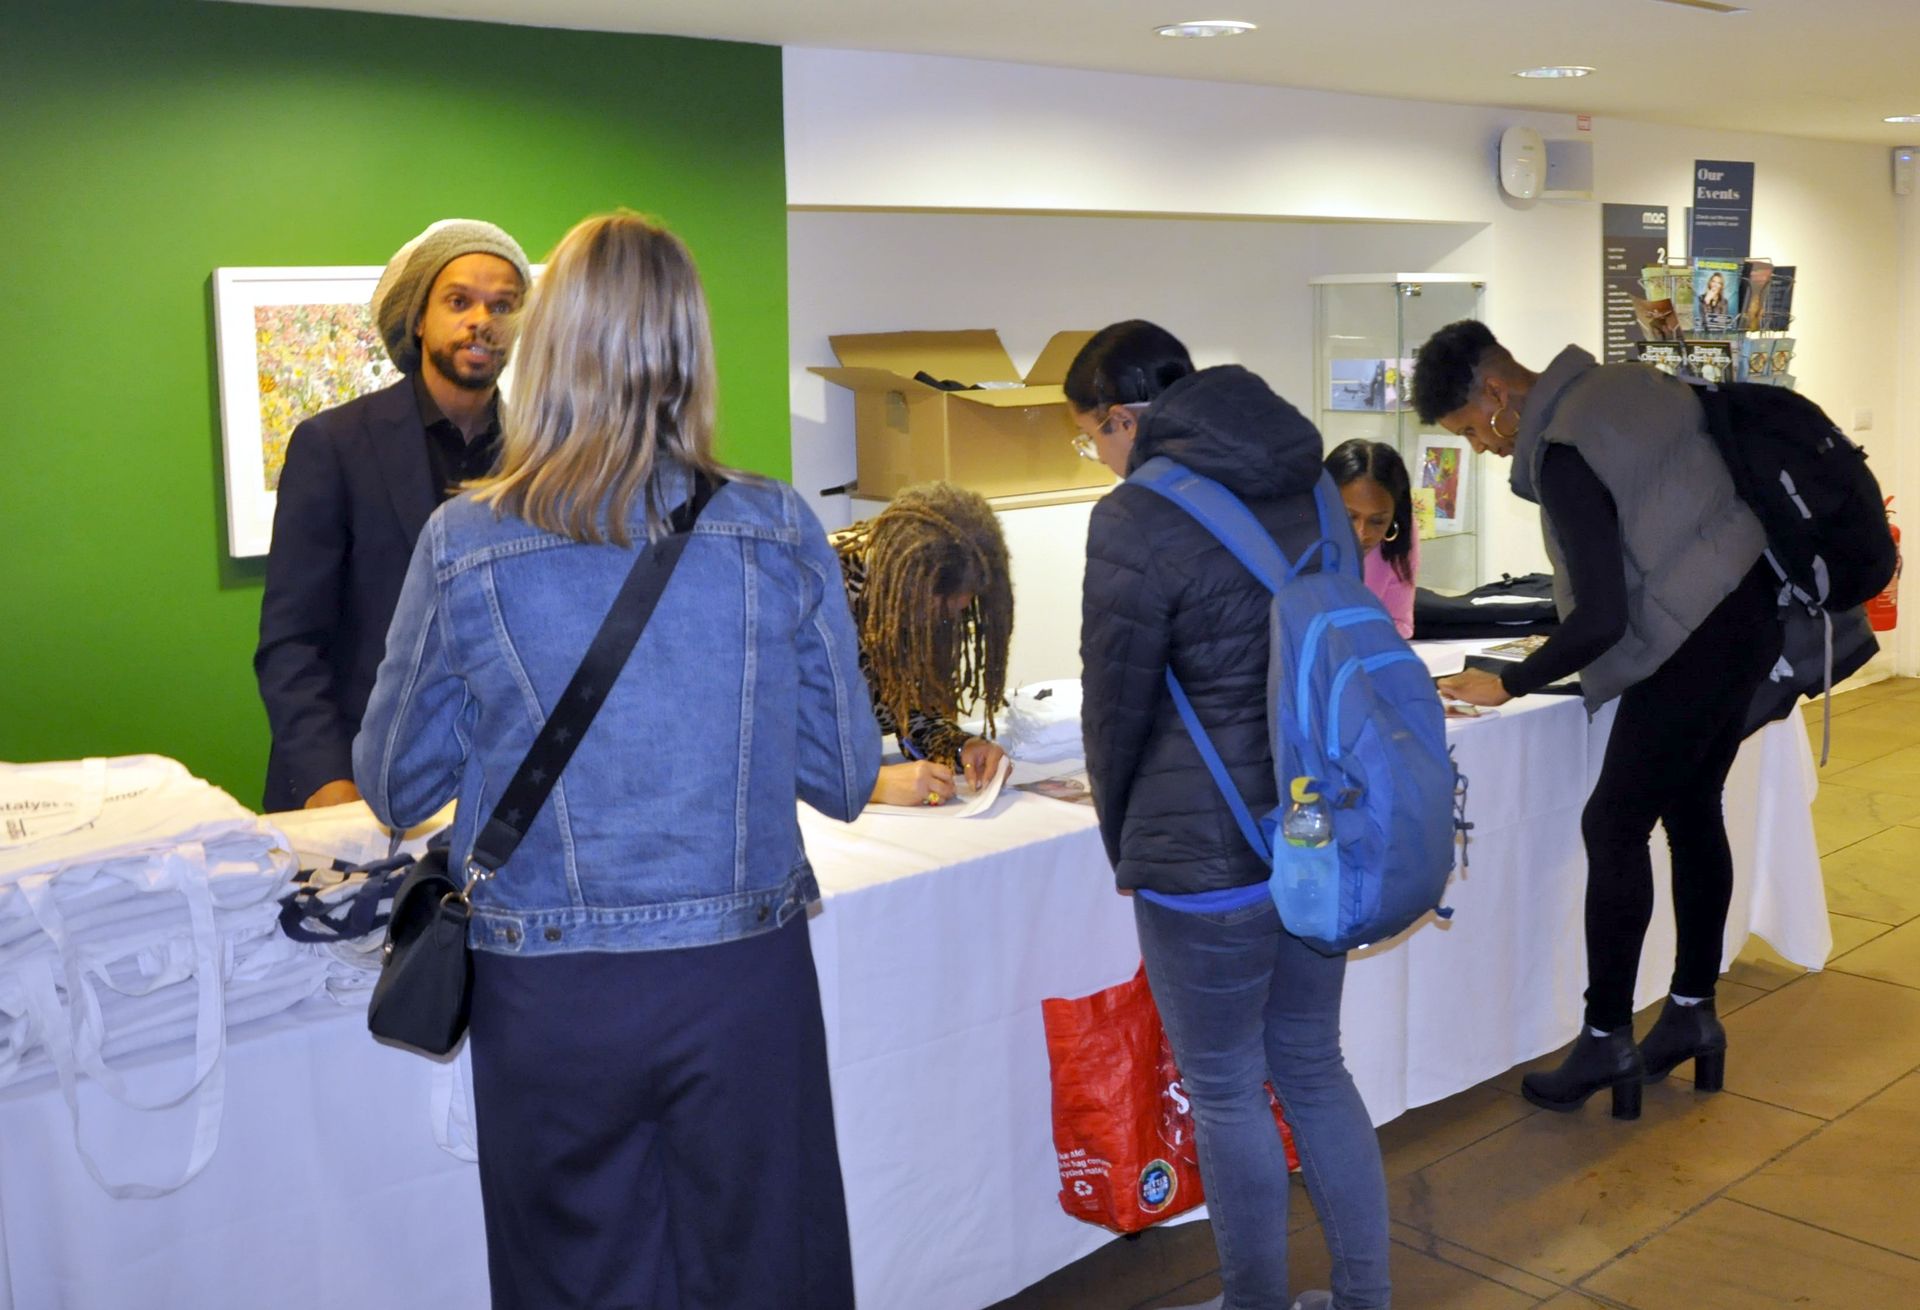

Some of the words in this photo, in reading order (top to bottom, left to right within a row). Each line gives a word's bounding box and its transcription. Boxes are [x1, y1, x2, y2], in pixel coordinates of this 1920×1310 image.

[1697, 168, 1725, 181] Our
[1696, 186, 1741, 200] Events
[1657, 247, 1665, 264] 2
